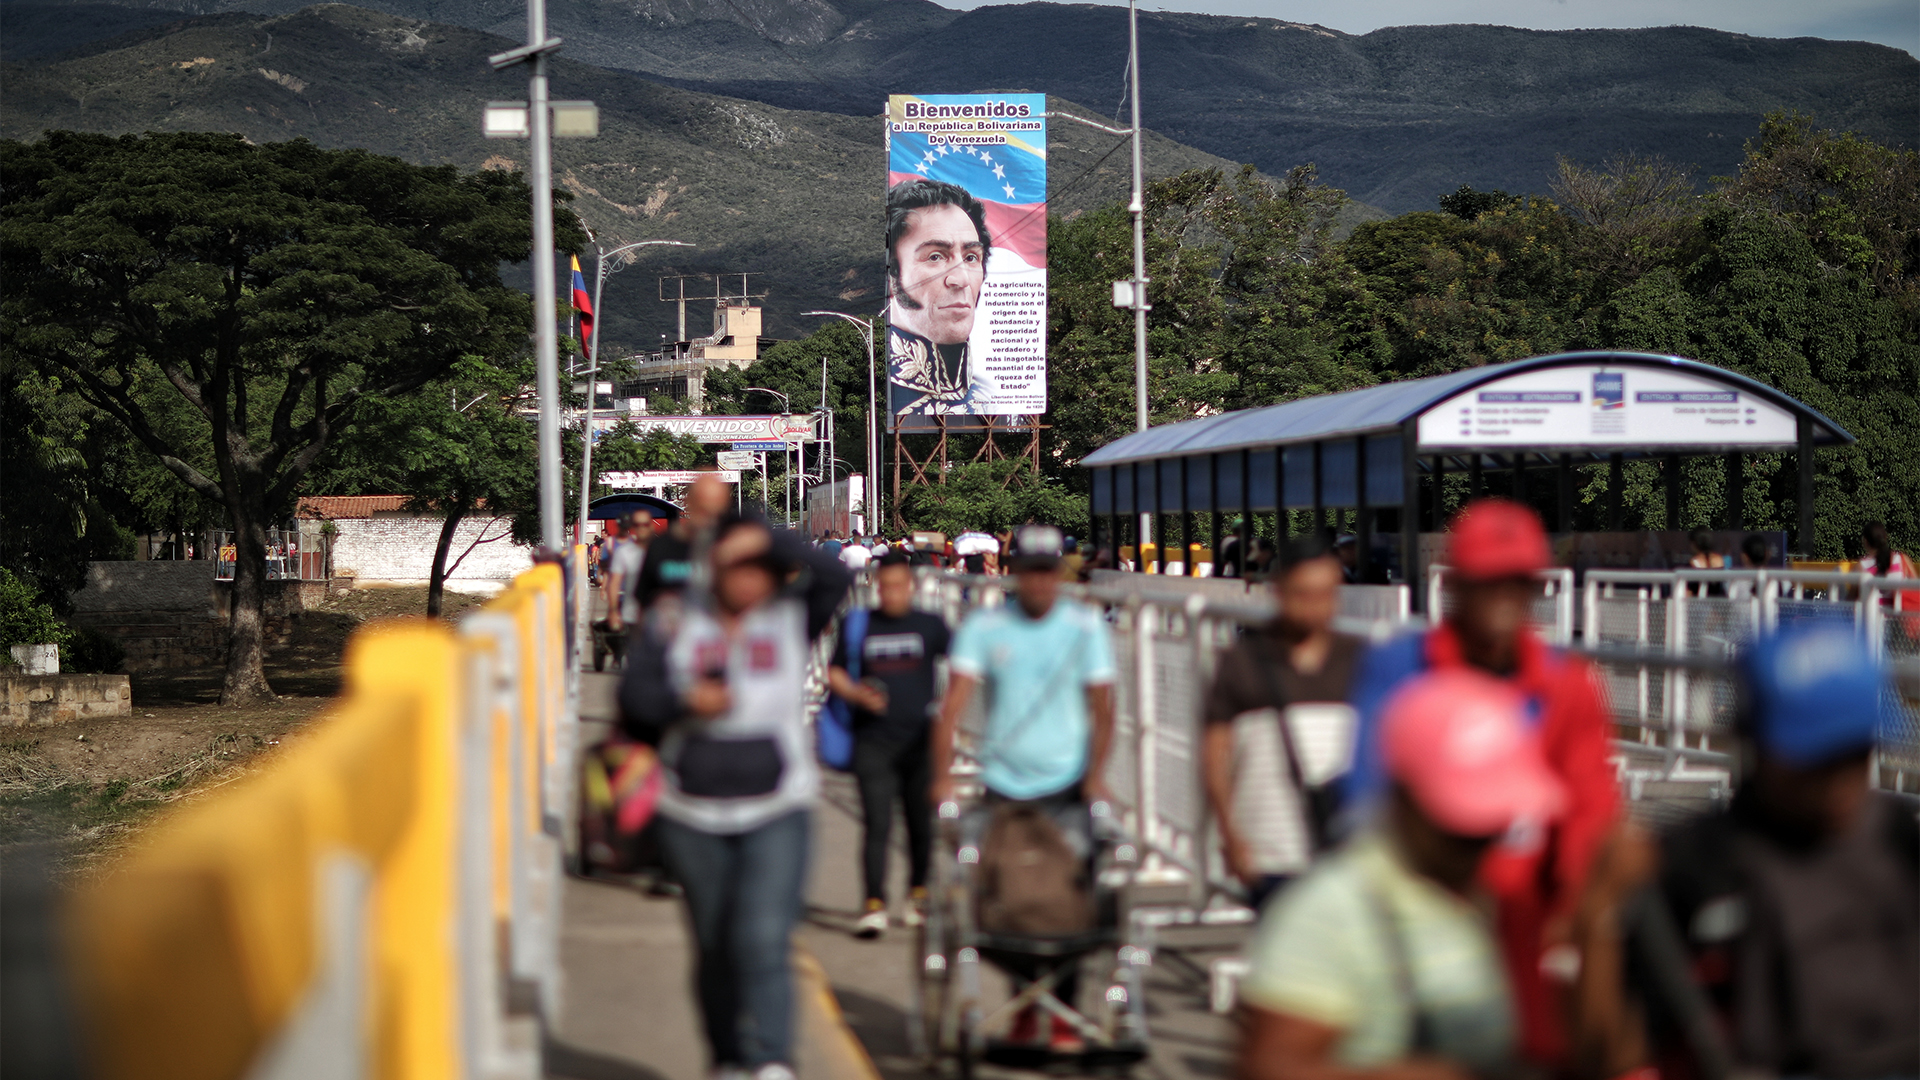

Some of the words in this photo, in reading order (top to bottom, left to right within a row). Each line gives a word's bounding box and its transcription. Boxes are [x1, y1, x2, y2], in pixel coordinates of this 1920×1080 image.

[905, 102, 1029, 117] Bienvenidos
[918, 122, 973, 132] República
[978, 121, 1041, 130] Bolivariana
